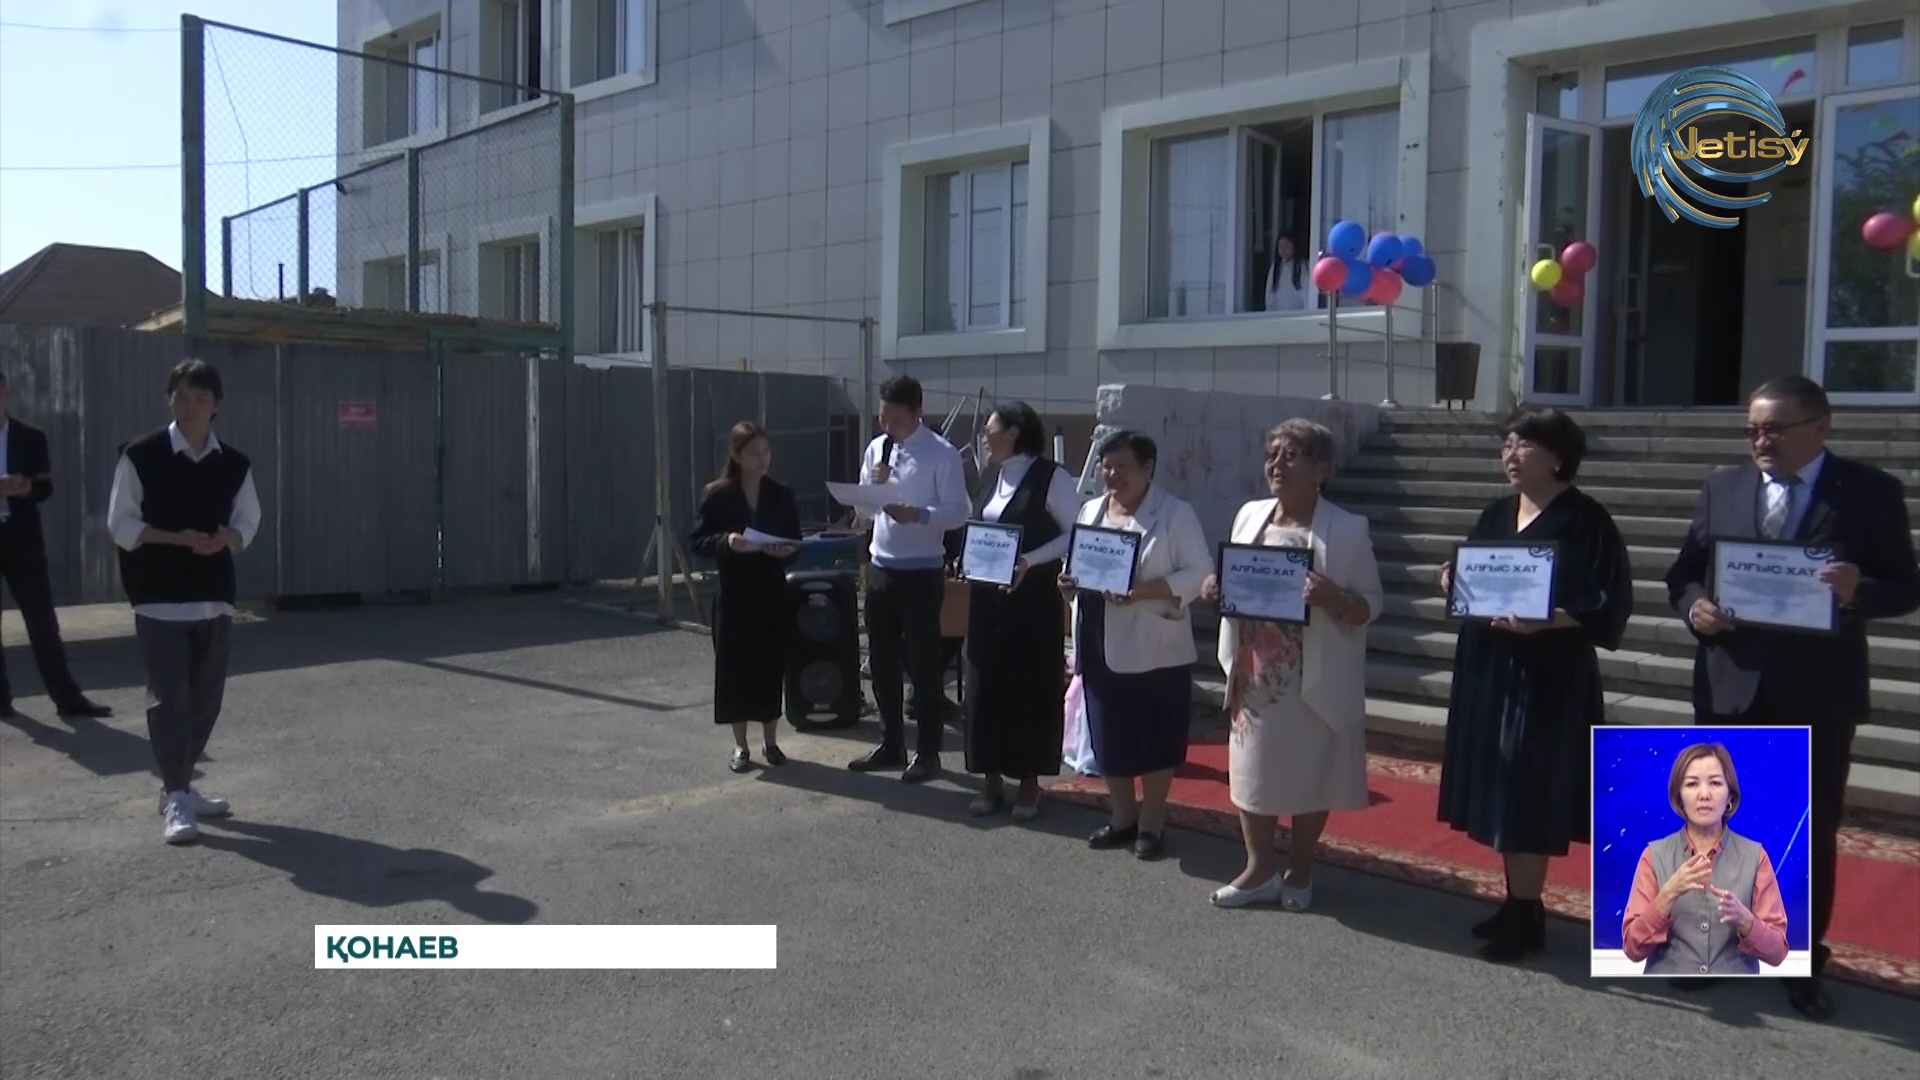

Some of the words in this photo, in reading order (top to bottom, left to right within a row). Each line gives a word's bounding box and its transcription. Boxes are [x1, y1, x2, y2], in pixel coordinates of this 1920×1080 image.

[1273, 567, 1296, 576] ХАТ
[1512, 565, 1539, 573] ХАТ
[1786, 567, 1818, 576] ХАТ
